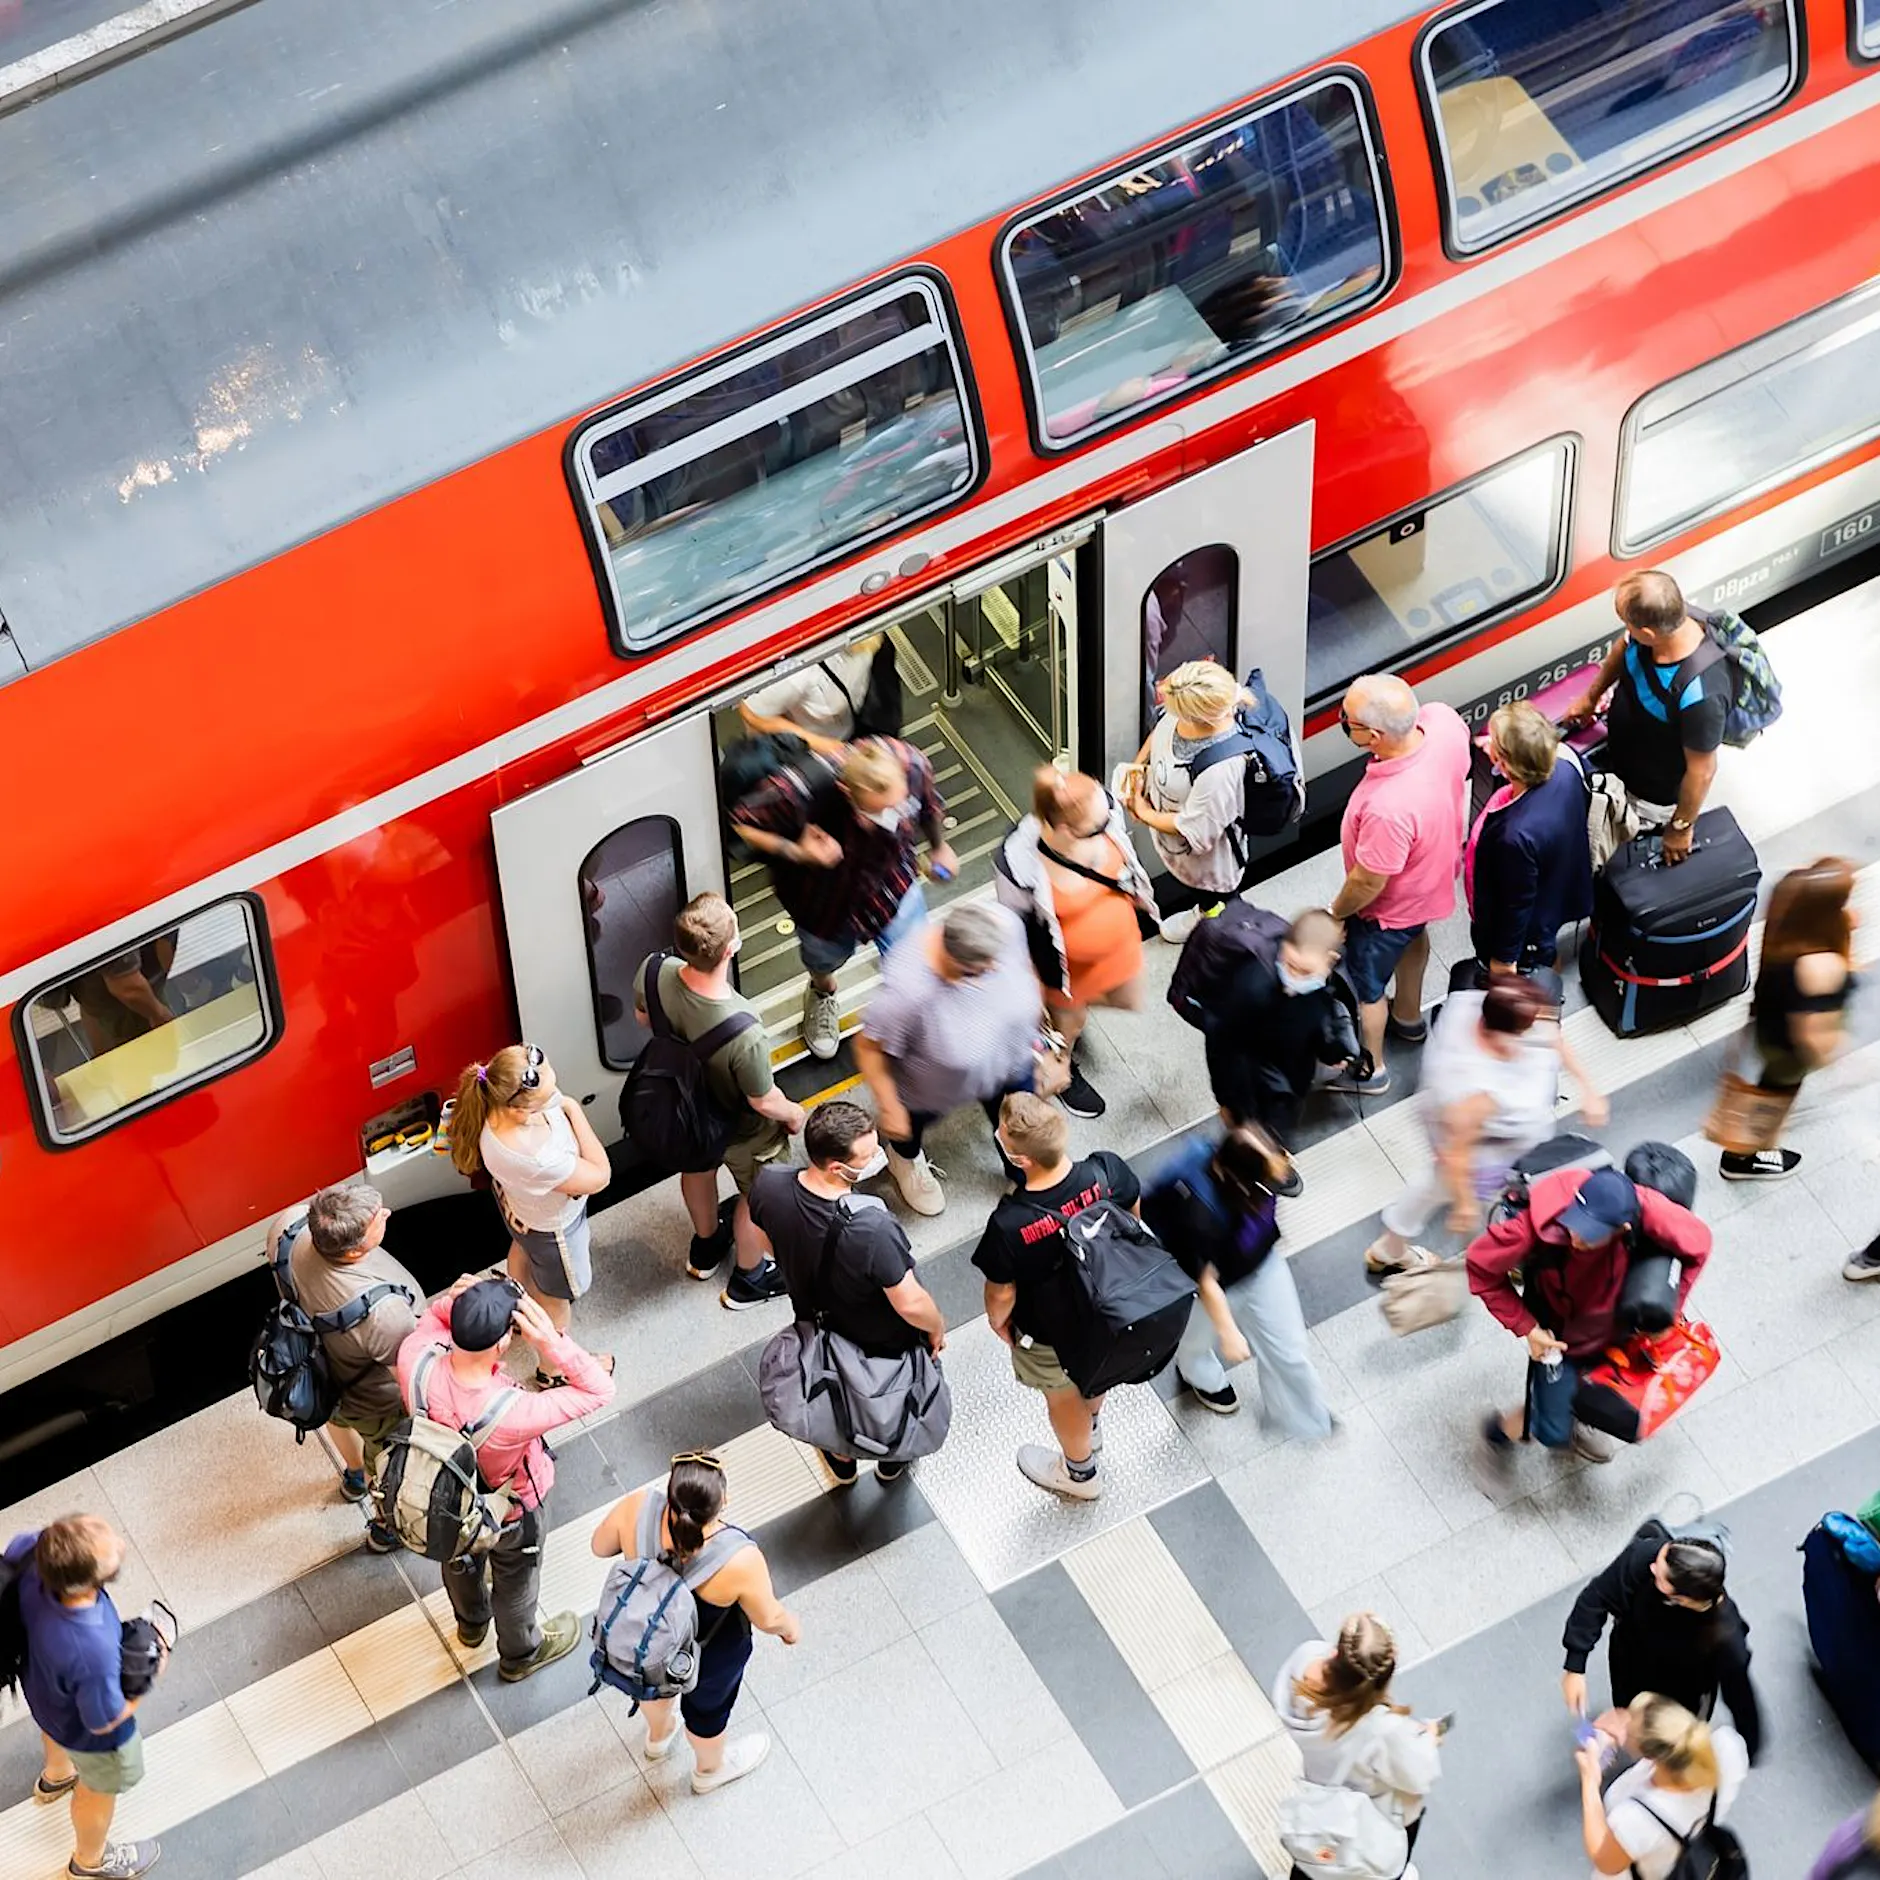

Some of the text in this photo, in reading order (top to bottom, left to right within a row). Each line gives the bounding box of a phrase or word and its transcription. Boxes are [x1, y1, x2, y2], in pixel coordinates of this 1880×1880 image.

[1833, 514, 1873, 546] 160
[1498, 683, 1528, 707] 80
[1713, 566, 1770, 604] DBpza
